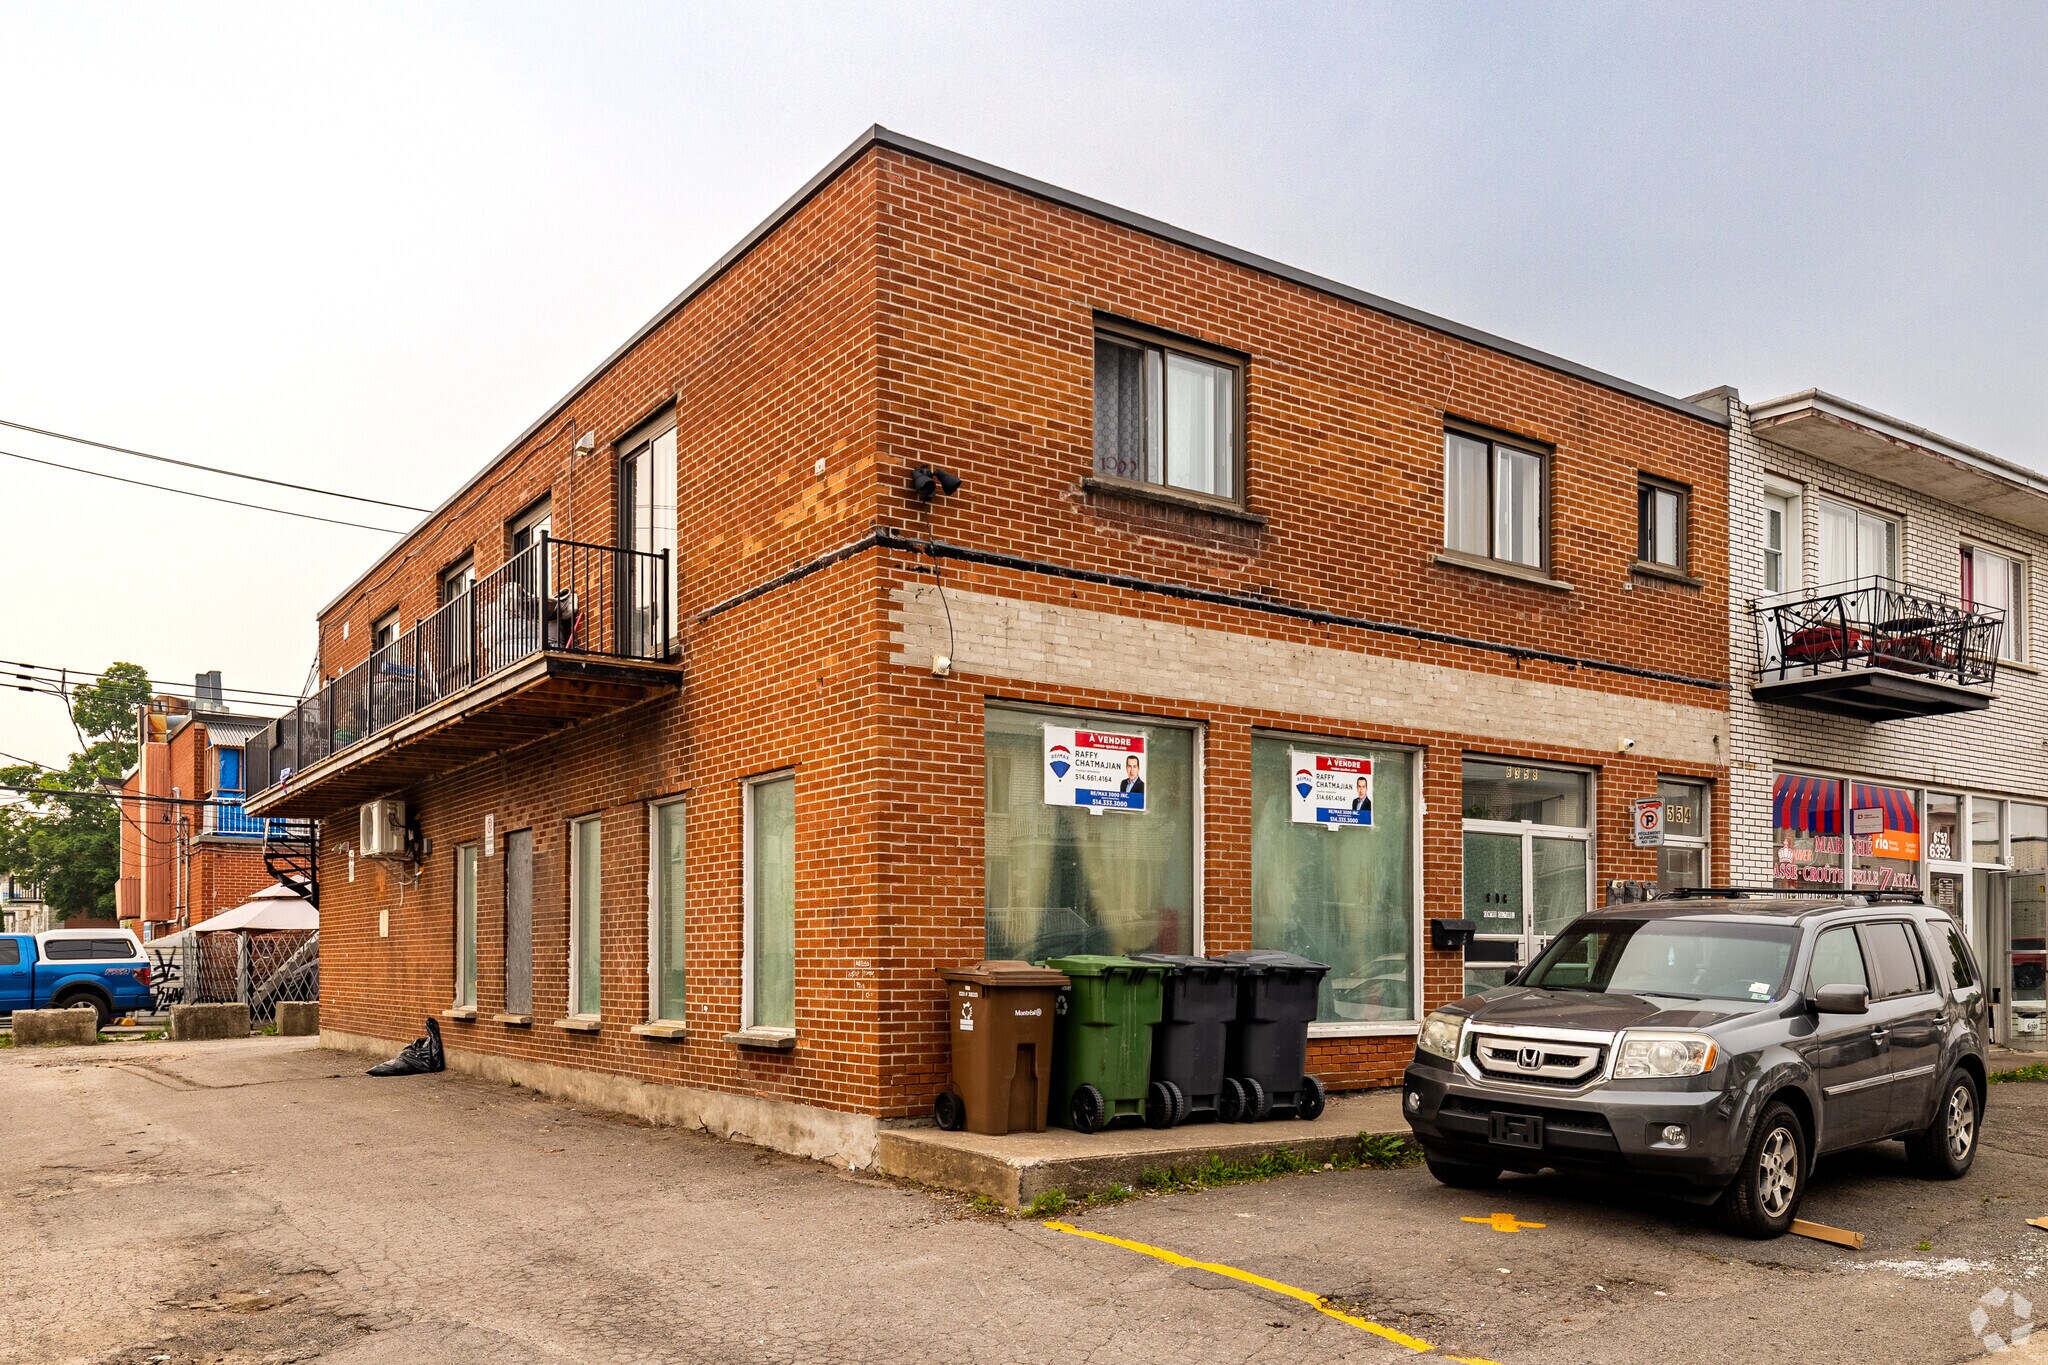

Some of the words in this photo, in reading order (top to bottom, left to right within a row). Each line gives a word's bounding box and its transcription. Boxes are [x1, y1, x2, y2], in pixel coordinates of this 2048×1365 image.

[1098, 736, 1131, 746] VENDRE
[1075, 750, 1098, 759] RAFFY
[1076, 760, 1121, 770] CHATMAJIAN
[1335, 760, 1361, 768] VENDRE
[1076, 774, 1112, 782] 514.661.4164
[1317, 782, 1353, 790] CHATMAJIAN
[1093, 799, 1127, 807] 514.333.3000
[1667, 805, 1691, 823] 354
[1929, 843, 1951, 859] 6352
